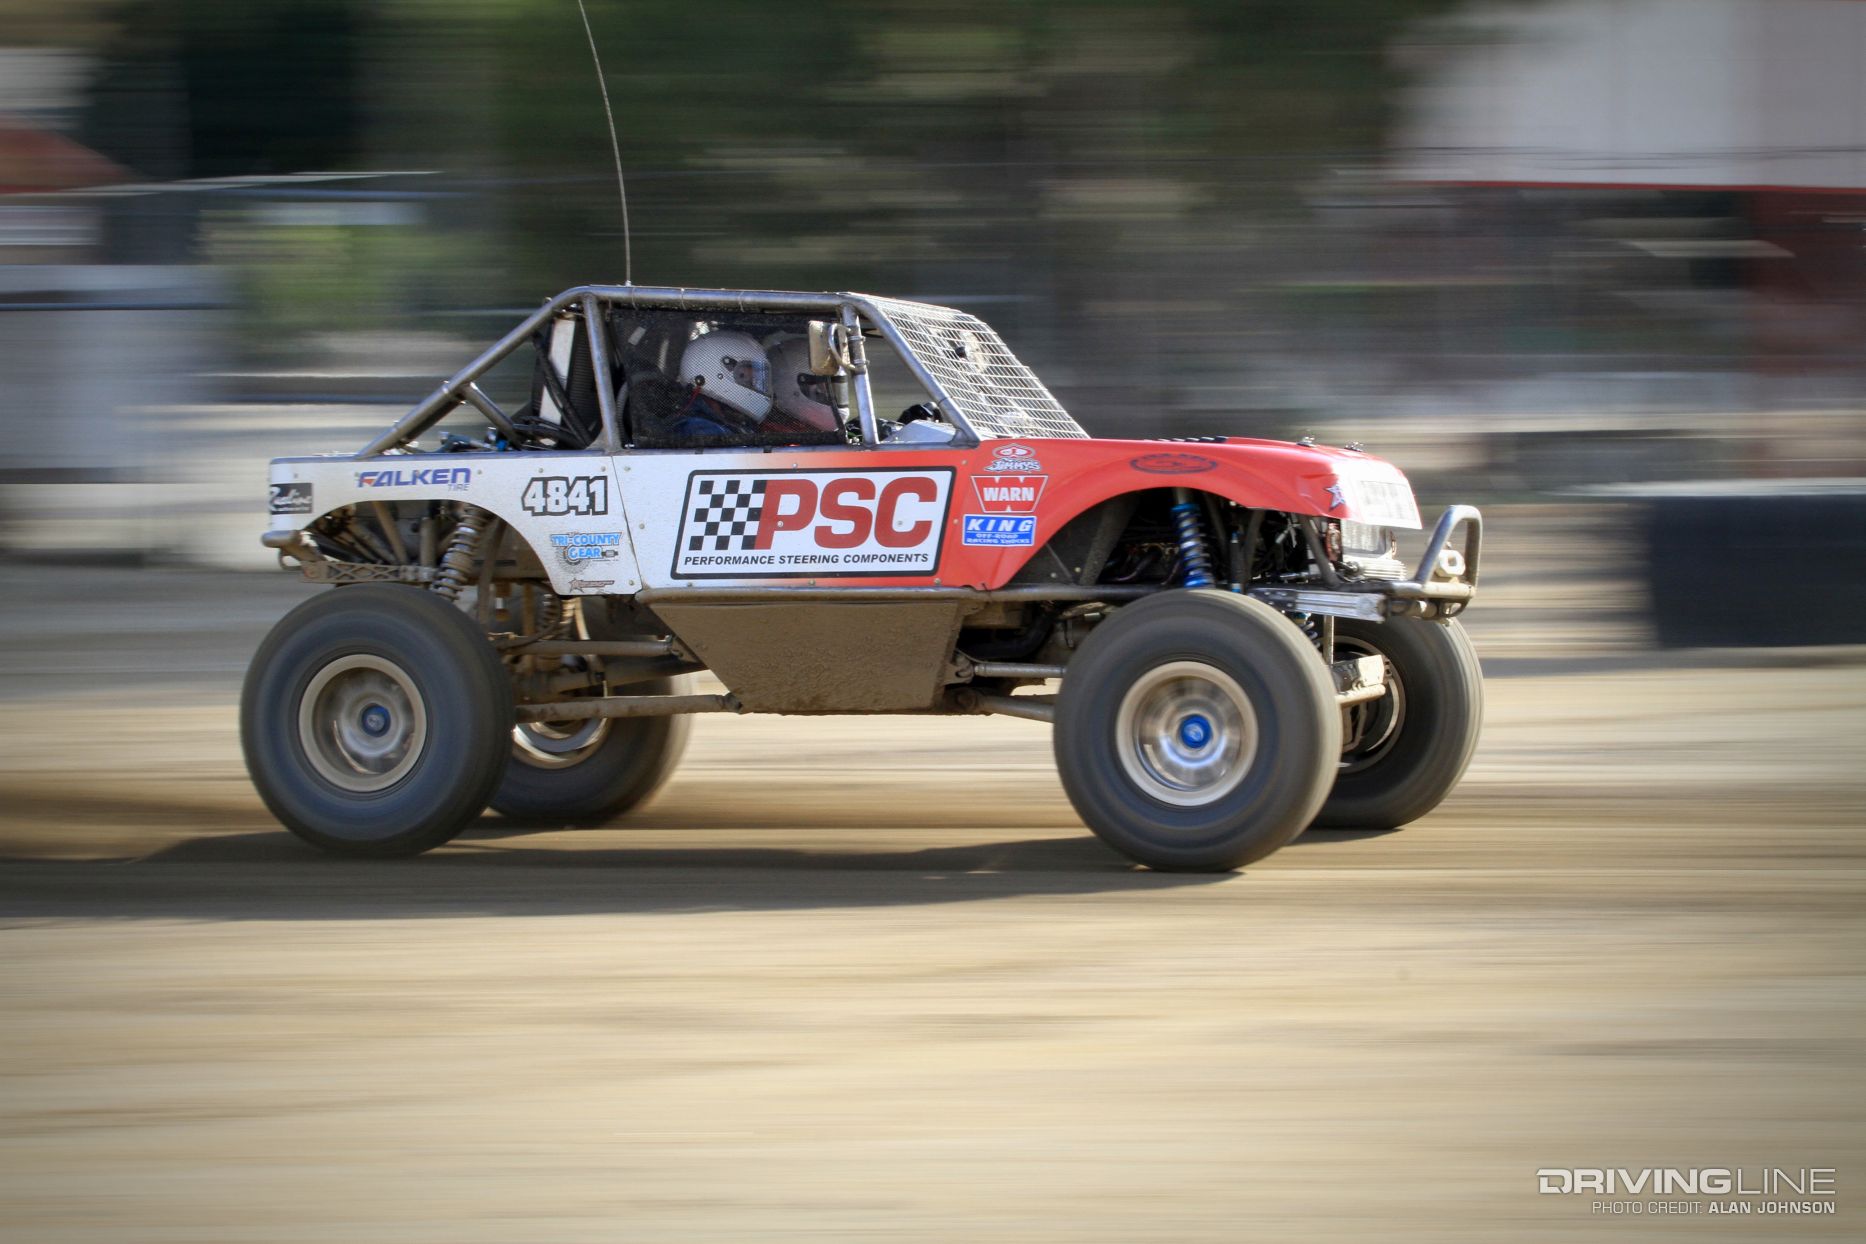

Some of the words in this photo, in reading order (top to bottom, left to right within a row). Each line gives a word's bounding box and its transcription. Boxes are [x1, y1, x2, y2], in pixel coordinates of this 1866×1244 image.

[358, 468, 471, 487] FALKEN
[521, 475, 608, 516] 4841
[983, 487, 1035, 502] WARN
[753, 476, 938, 550] PSC
[967, 518, 1033, 532] KING
[550, 533, 621, 546] TRI-COUNTY
[567, 545, 602, 559] GEAR
[684, 555, 775, 566] PERFORMANCE
[778, 554, 840, 565] STEERING
[843, 553, 929, 564] COMPONENTS
